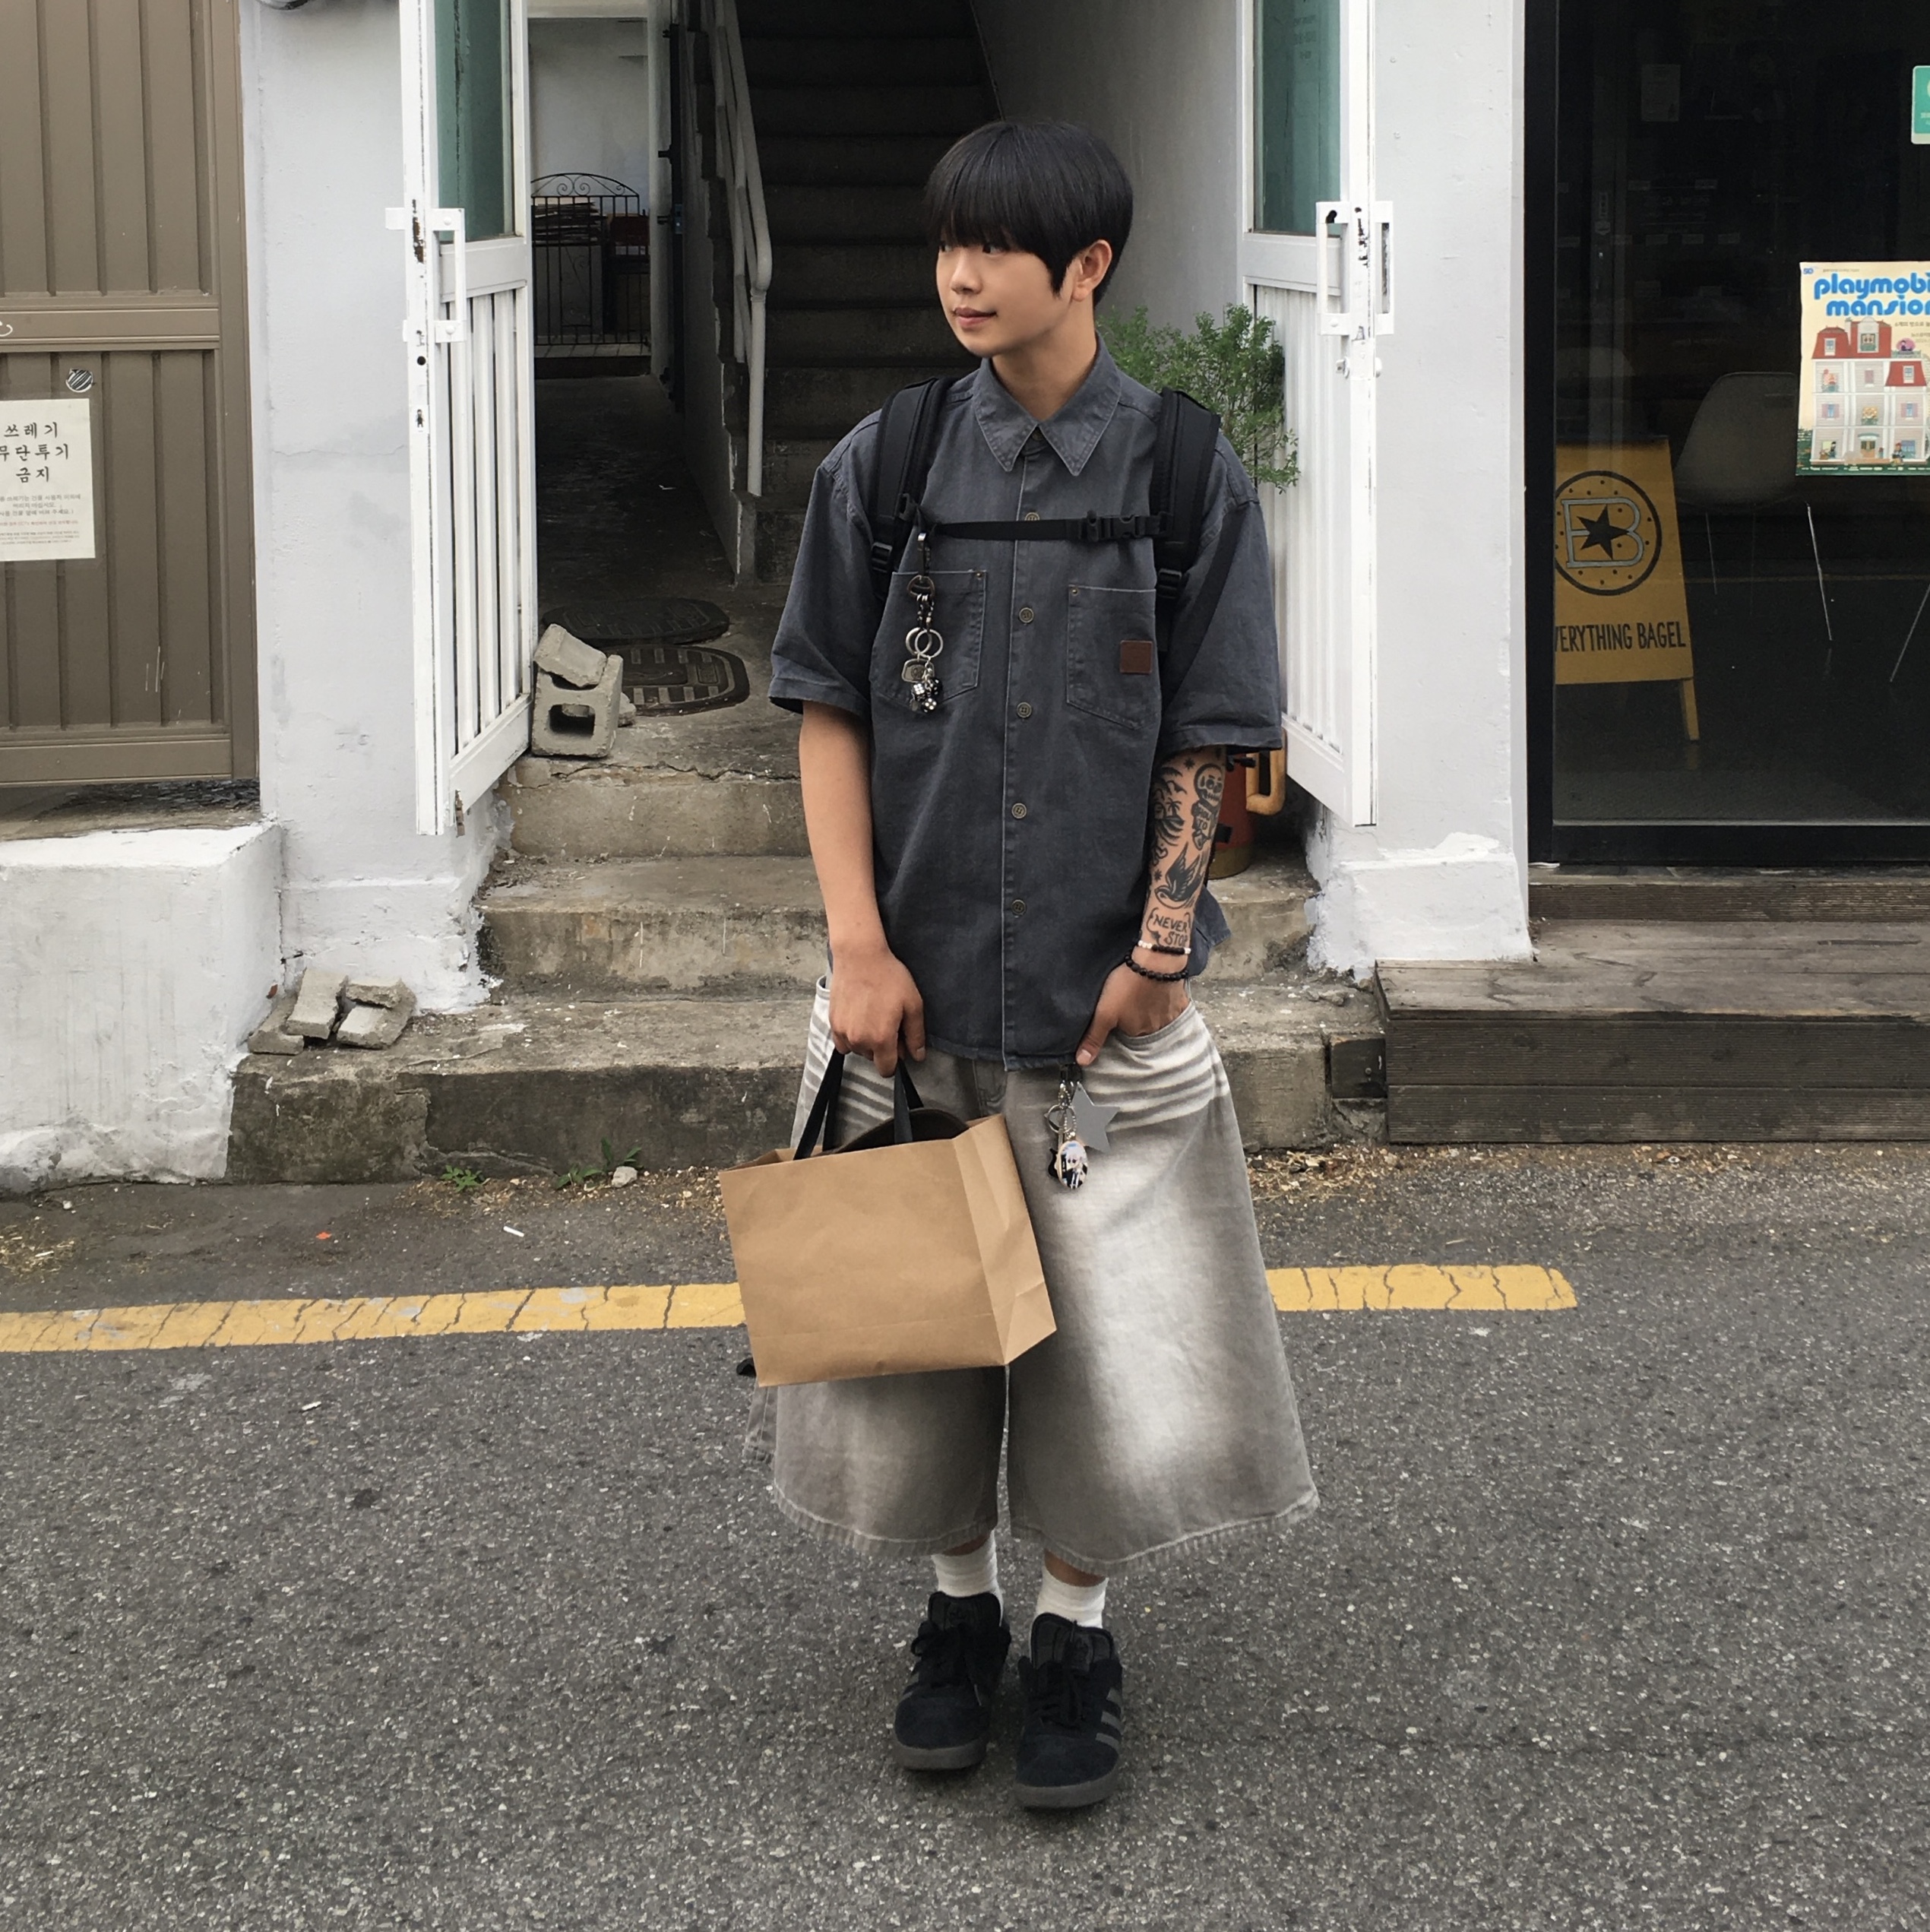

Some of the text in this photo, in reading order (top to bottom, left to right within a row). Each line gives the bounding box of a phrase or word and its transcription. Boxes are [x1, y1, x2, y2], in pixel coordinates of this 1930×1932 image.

[4, 422, 57, 439] 쓰레기
[0, 443, 68, 461] 무단투기
[16, 466, 49, 483] 금지
[1637, 621, 1686, 649] BAGEL
[1153, 914, 1187, 933] NEVER
